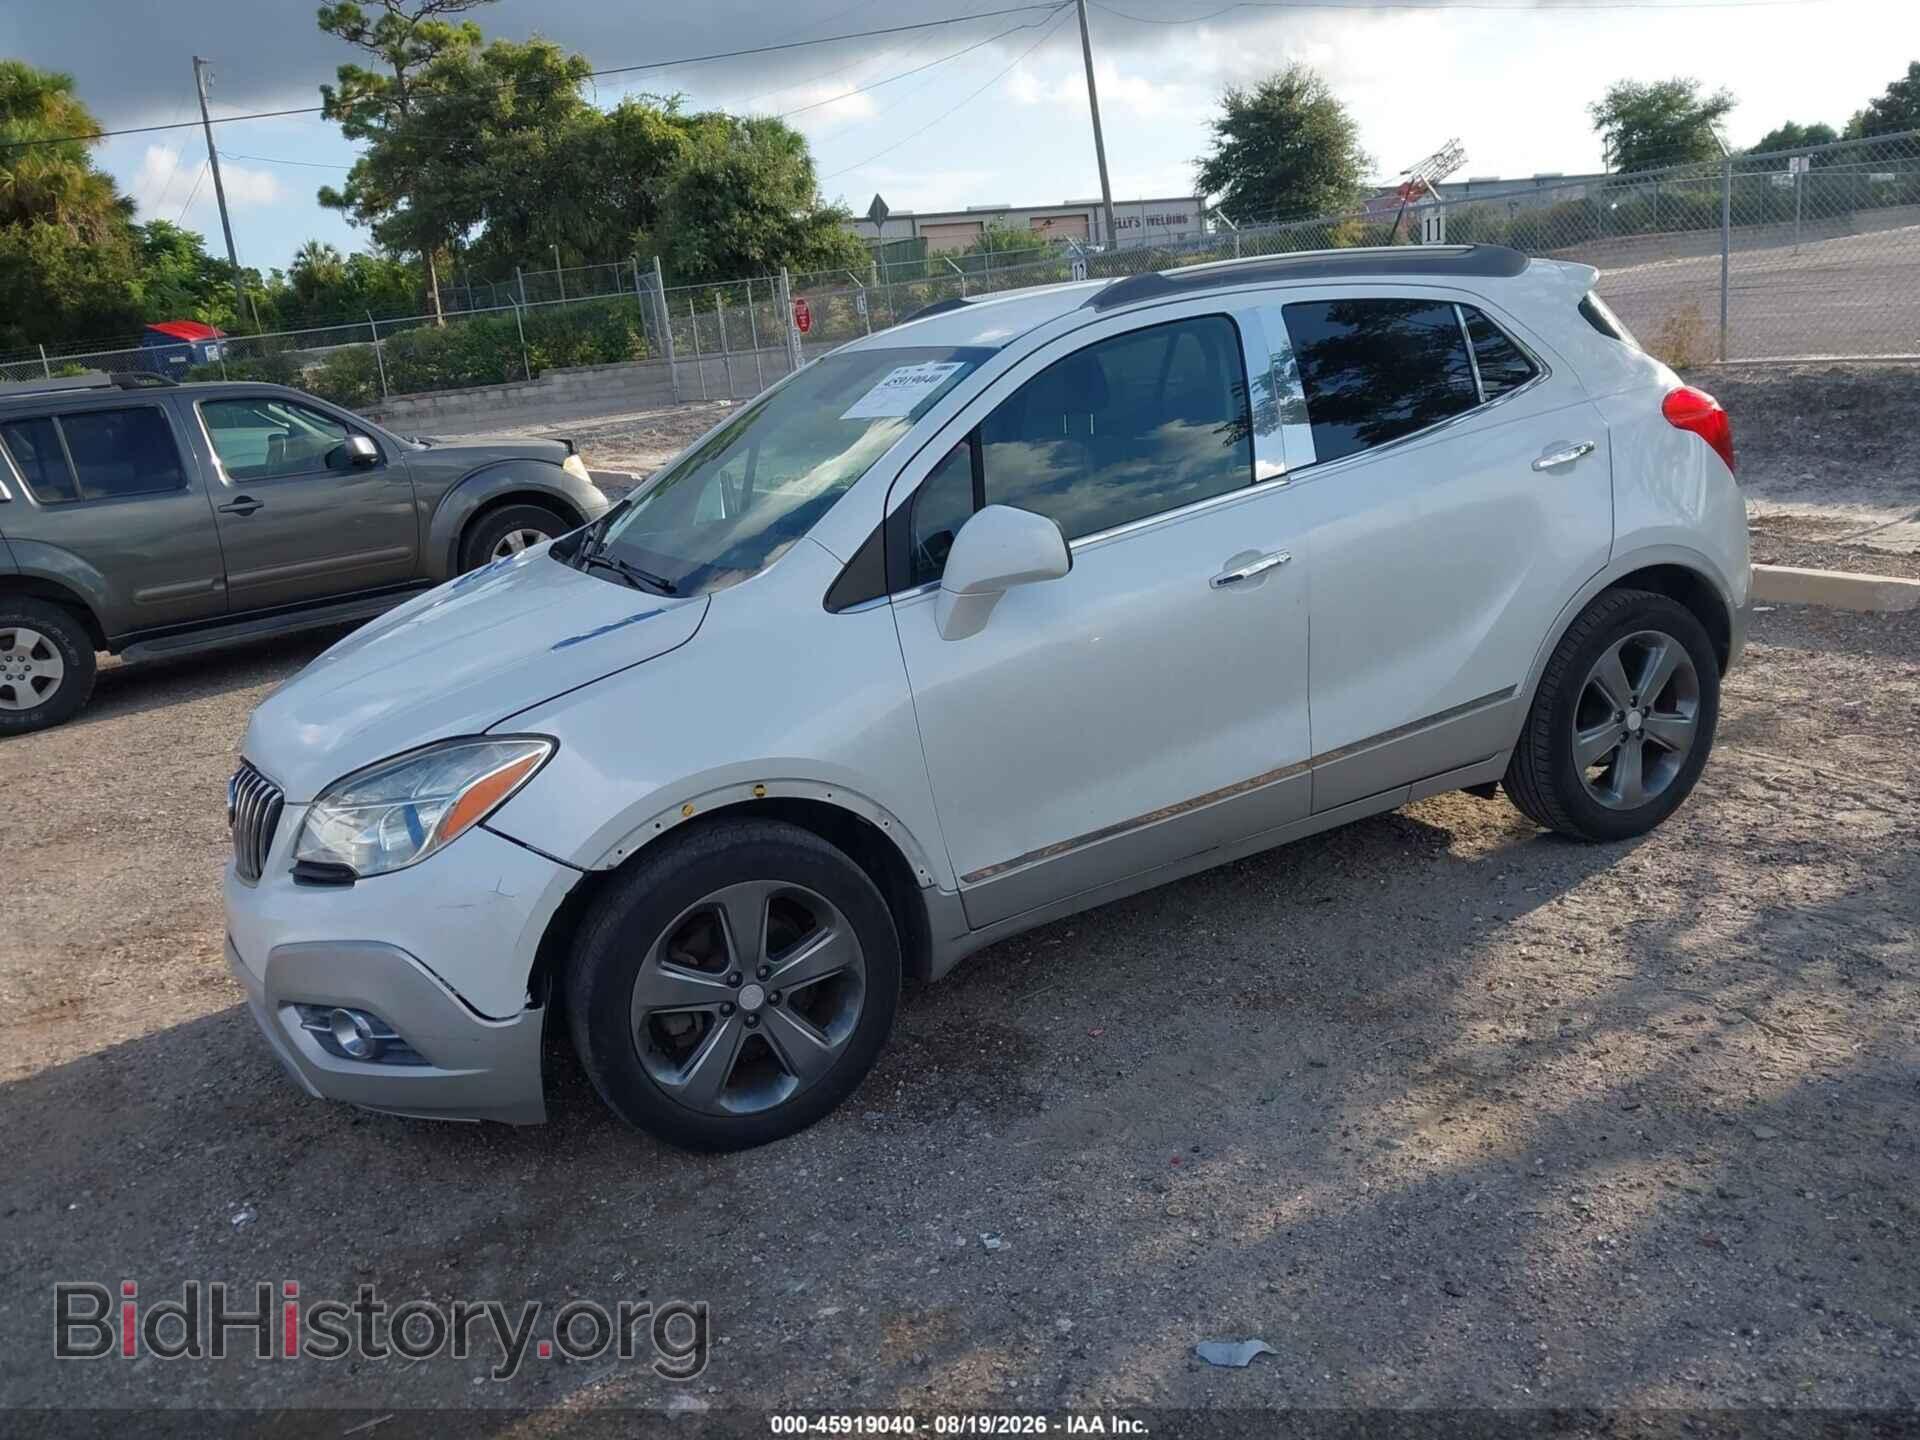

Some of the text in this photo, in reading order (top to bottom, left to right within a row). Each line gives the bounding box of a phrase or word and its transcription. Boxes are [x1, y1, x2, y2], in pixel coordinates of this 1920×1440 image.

[1113, 214, 1188, 229] ELLY'S WELDING
[1426, 217, 1441, 241] 11
